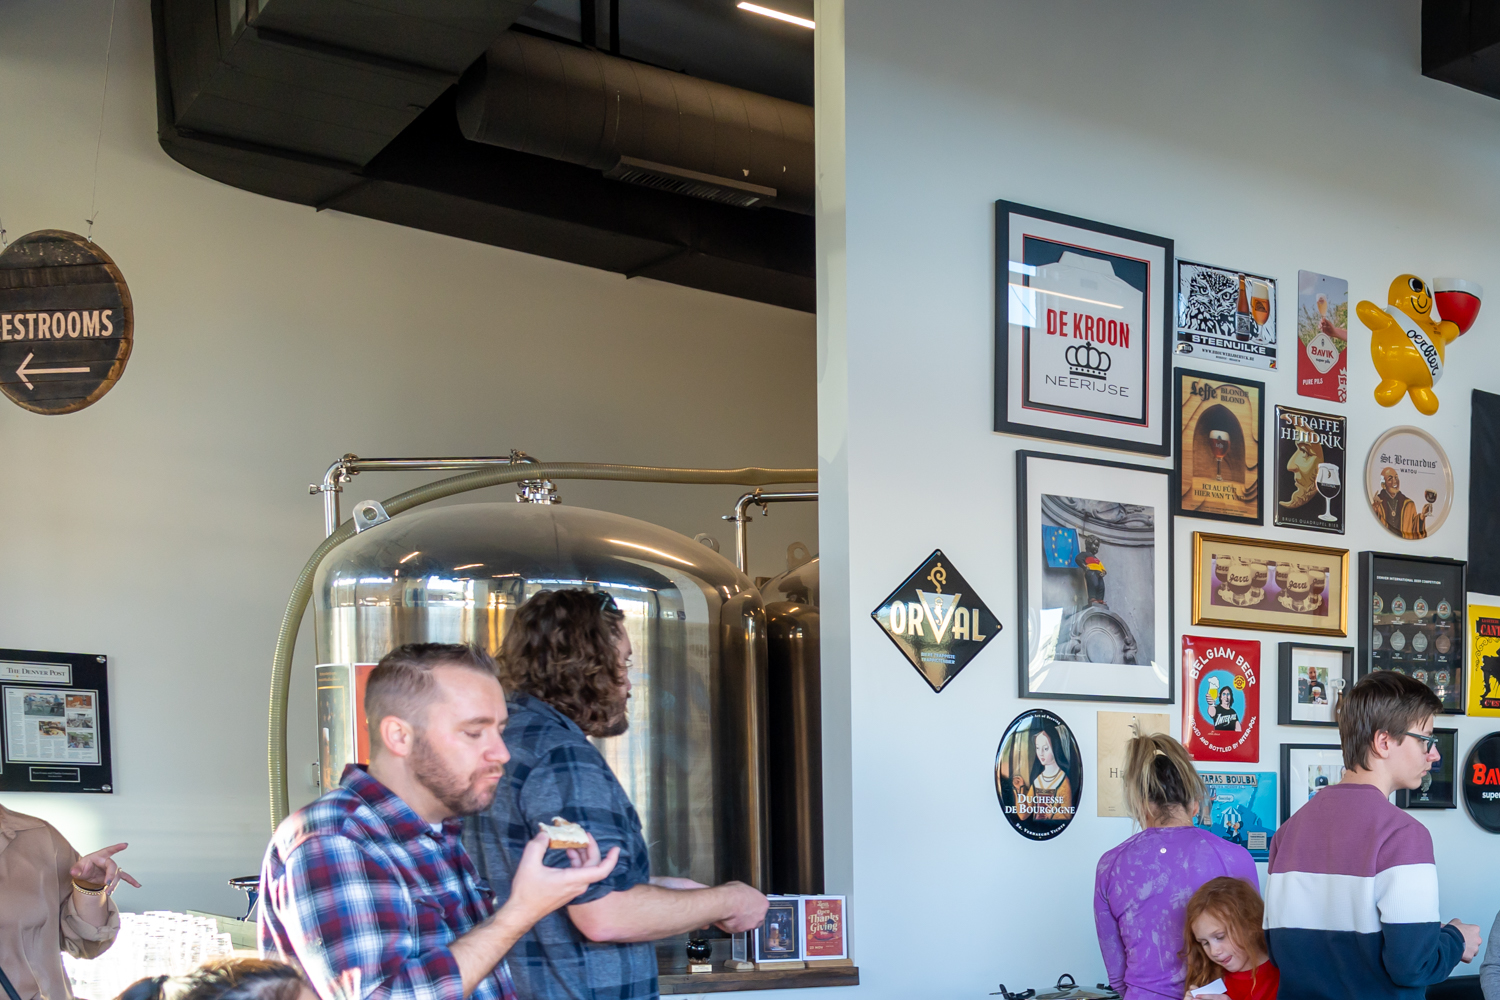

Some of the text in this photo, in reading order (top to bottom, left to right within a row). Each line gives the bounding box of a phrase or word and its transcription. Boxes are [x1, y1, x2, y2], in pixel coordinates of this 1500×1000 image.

[0, 309, 113, 340] ESTROOMS
[1046, 308, 1130, 349] DE KROON
[1191, 334, 1266, 354] STEENUILKE
[1311, 346, 1334, 359] BAVIK
[1406, 329, 1440, 376] oerbier
[1045, 374, 1130, 398] NEERIJSE
[1190, 381, 1217, 402] Leffe
[1220, 387, 1249, 398] BLONDE
[1220, 395, 1245, 404] BLOND
[1285, 412, 1340, 433] STRAFFE
[1281, 427, 1344, 450] HENDRIK
[1394, 454, 1436, 469] Bernardus
[1194, 489, 1210, 497] HIER
[889, 588, 987, 645] ORVAL
[22, 668, 49, 676] DENVER
[49, 669, 66, 677] POST
[1189, 647, 1235, 680] BELGIAN
[1235, 655, 1256, 688] BEER
[1208, 743, 1232, 753] BOTTLED
[1200, 774, 1256, 784] TARAS BOULBA
[1017, 793, 1064, 804] DUCHESSE
[1005, 804, 1075, 814] DE BOURGOGNE
[807, 912, 839, 923] Thanks
[810, 922, 838, 935] Giving
